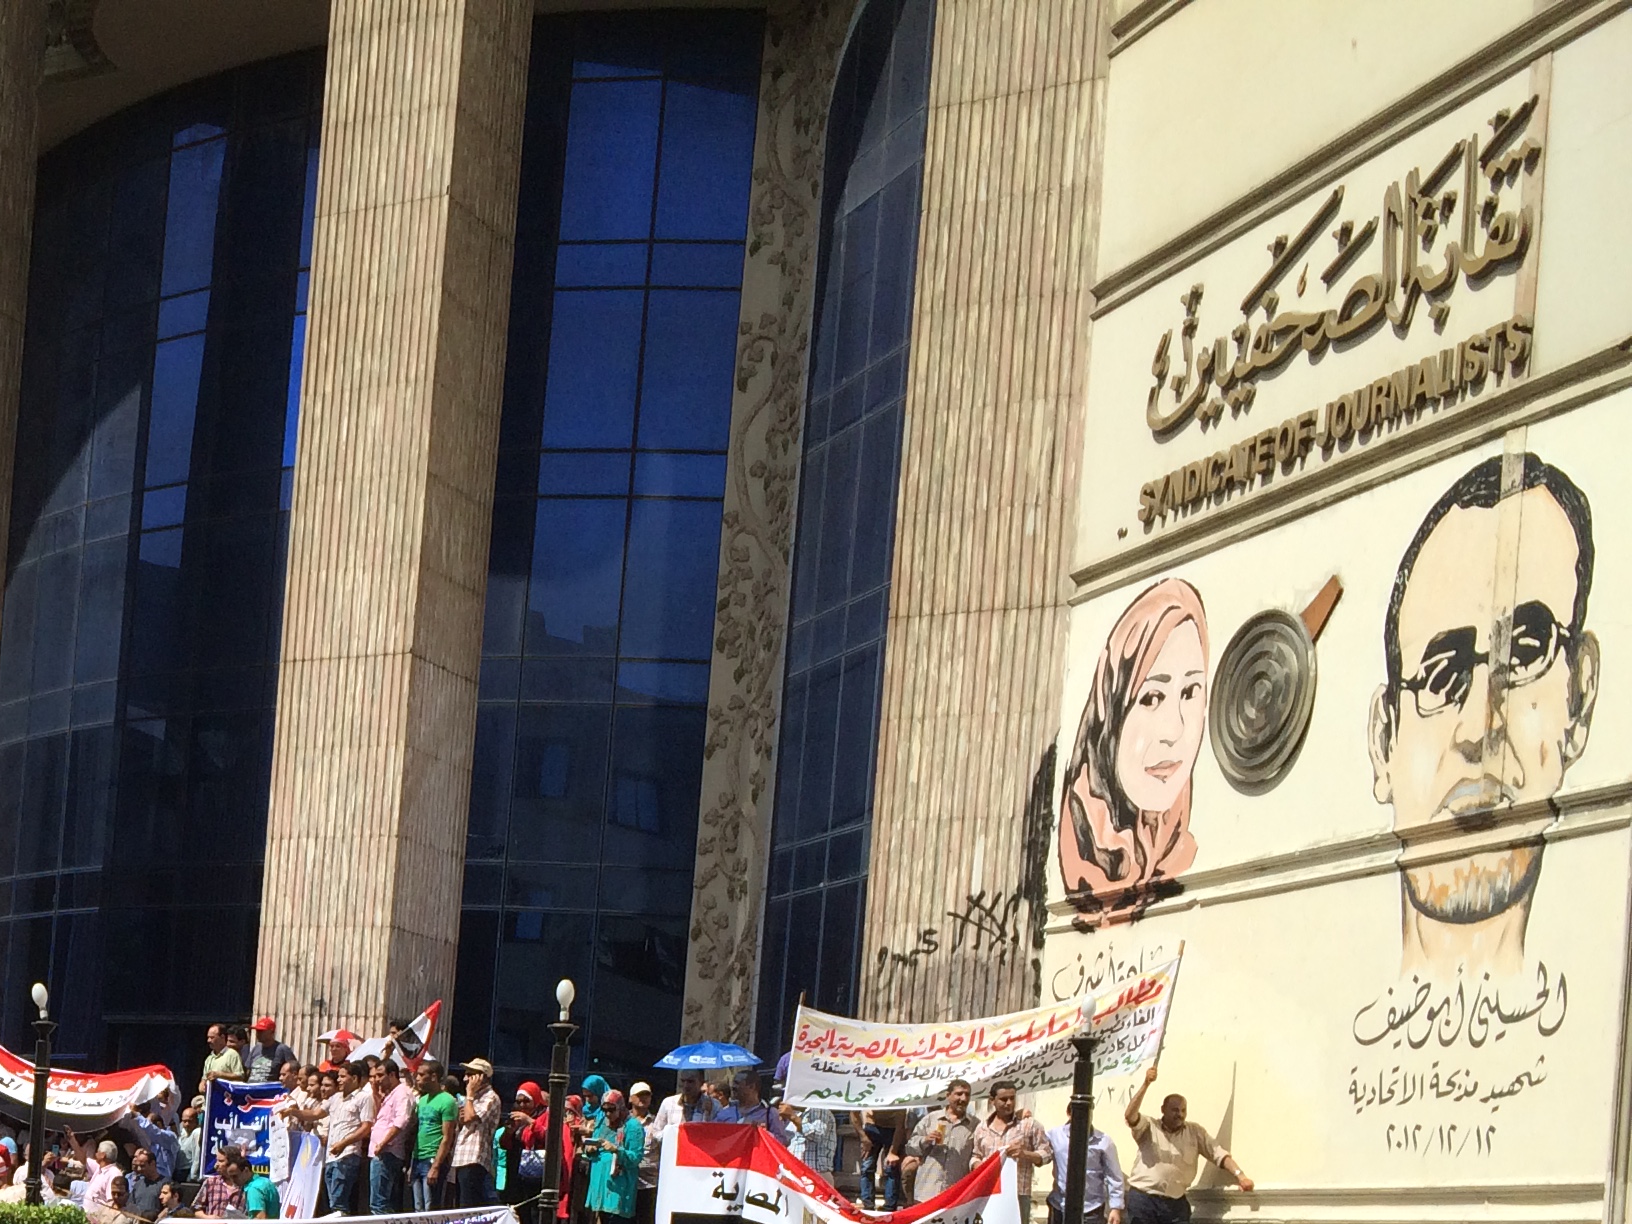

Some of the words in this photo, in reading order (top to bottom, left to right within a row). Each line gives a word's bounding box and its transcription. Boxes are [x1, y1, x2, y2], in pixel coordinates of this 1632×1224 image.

[1410, 110, 1543, 332] نقابة
[1145, 175, 1420, 440] الصحفيين
[1137, 435, 1276, 530] SYNDICATE
[1274, 409, 1316, 462] OF
[1314, 315, 1532, 448] JOURNALISTS
[990, 1004, 1084, 1053] لعاملين
[1429, 1061, 1479, 1103] مذبحة
[1479, 1055, 1548, 1113] شهيد
